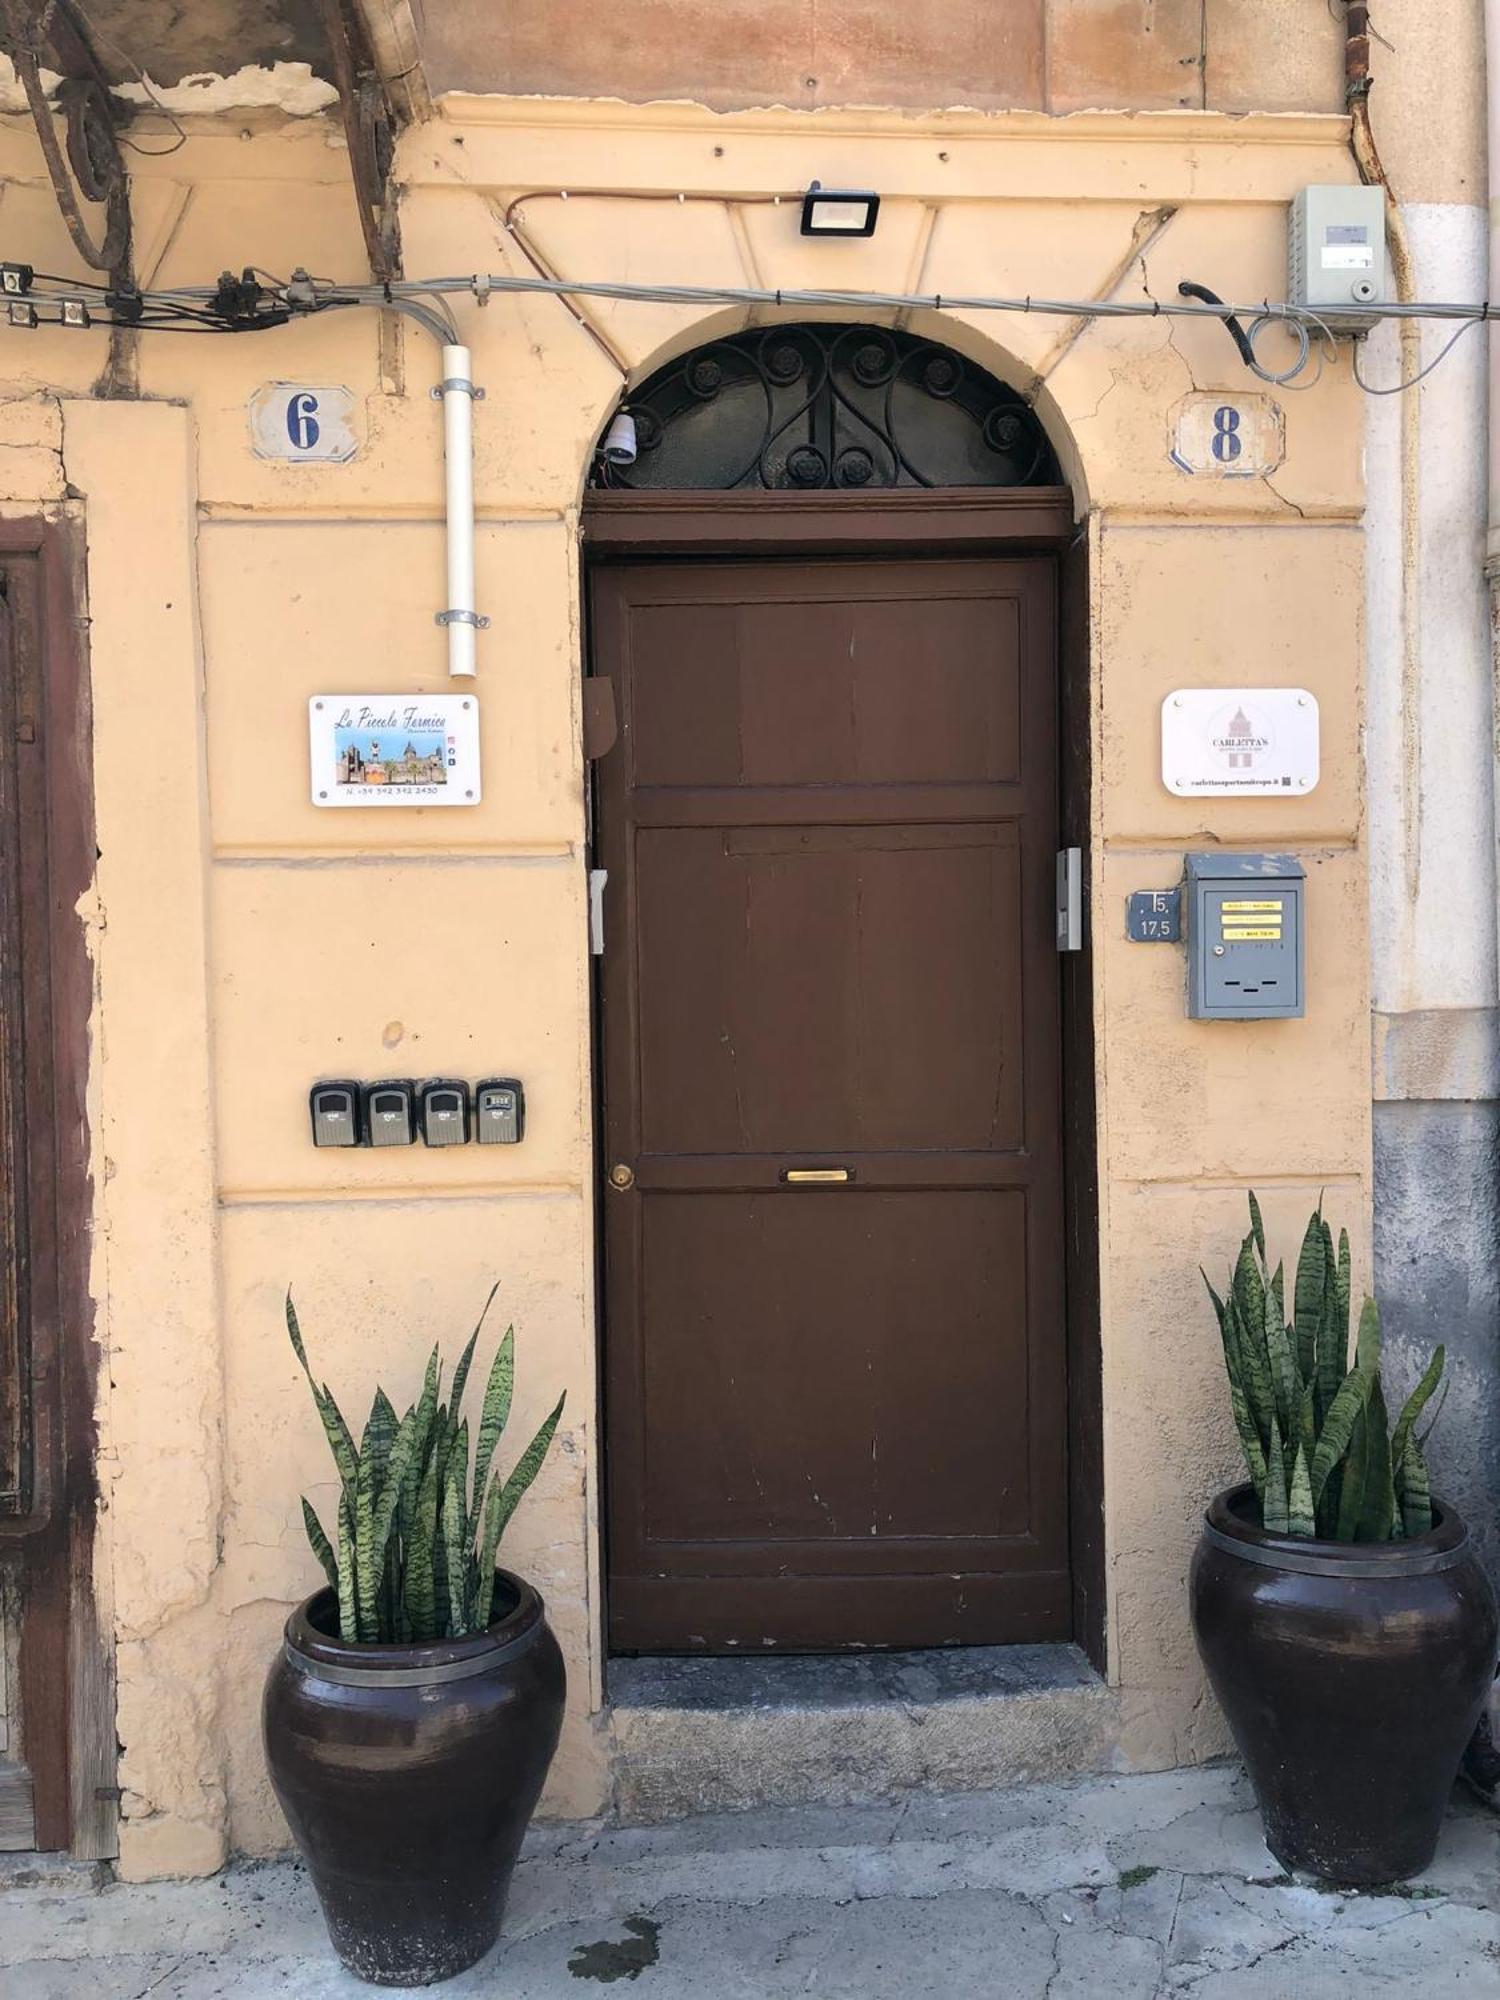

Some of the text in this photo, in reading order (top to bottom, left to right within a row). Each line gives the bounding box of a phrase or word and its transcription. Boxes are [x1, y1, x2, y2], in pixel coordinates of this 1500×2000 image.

[287, 393, 320, 449] 6
[1211, 406, 1242, 463] 8
[1141, 920, 1170, 938] 17,5
